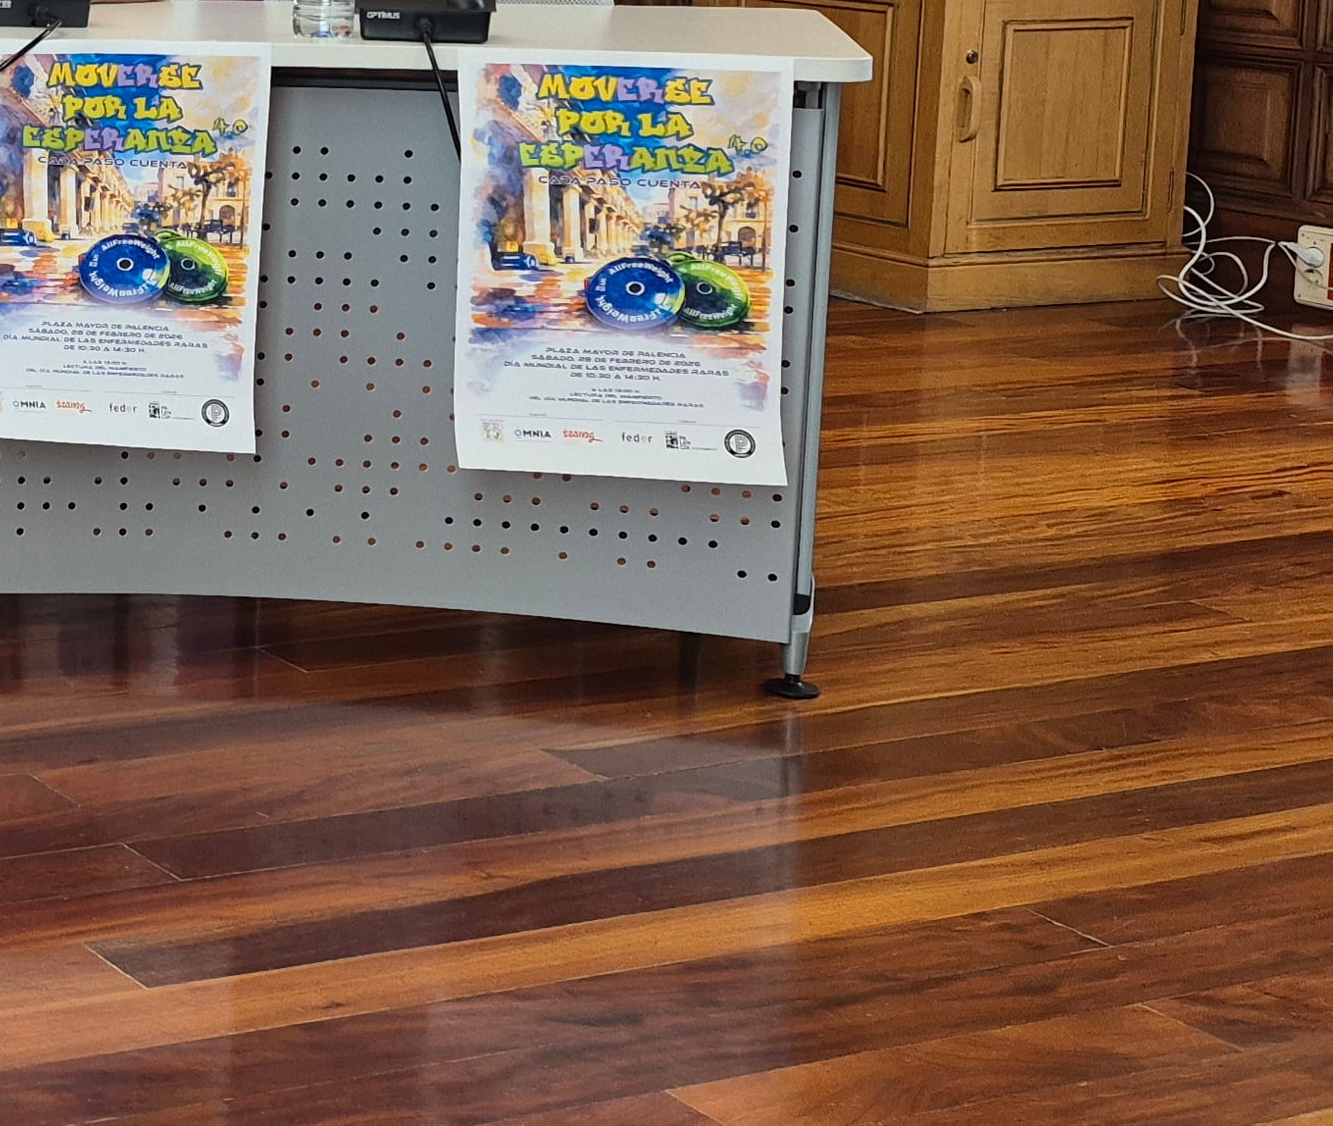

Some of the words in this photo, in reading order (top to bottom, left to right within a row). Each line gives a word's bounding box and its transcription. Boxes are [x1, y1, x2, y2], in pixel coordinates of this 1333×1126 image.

[47, 62, 203, 89] MOVERSE
[537, 75, 716, 106] MOVERSE
[62, 94, 127, 122] POR
[133, 96, 183, 123] LA
[556, 107, 632, 137] POR
[636, 112, 695, 141] LA
[22, 124, 218, 157] ESPERANZA
[38, 156, 82, 165] CADA
[84, 158, 124, 167] PASO
[130, 159, 187, 169] CUENTA
[517, 139, 735, 177] ESPERANZA
[538, 176, 584, 185] CADA
[587, 177, 632, 187] PASO
[637, 178, 701, 189] CUENTA
[99, 339, 171, 347] ENFERMEDADES
[523, 362, 567, 370] MUNDIAL
[609, 365, 689, 374] ENFERMEDADES
[609, 357, 656, 365] FEBRERO
